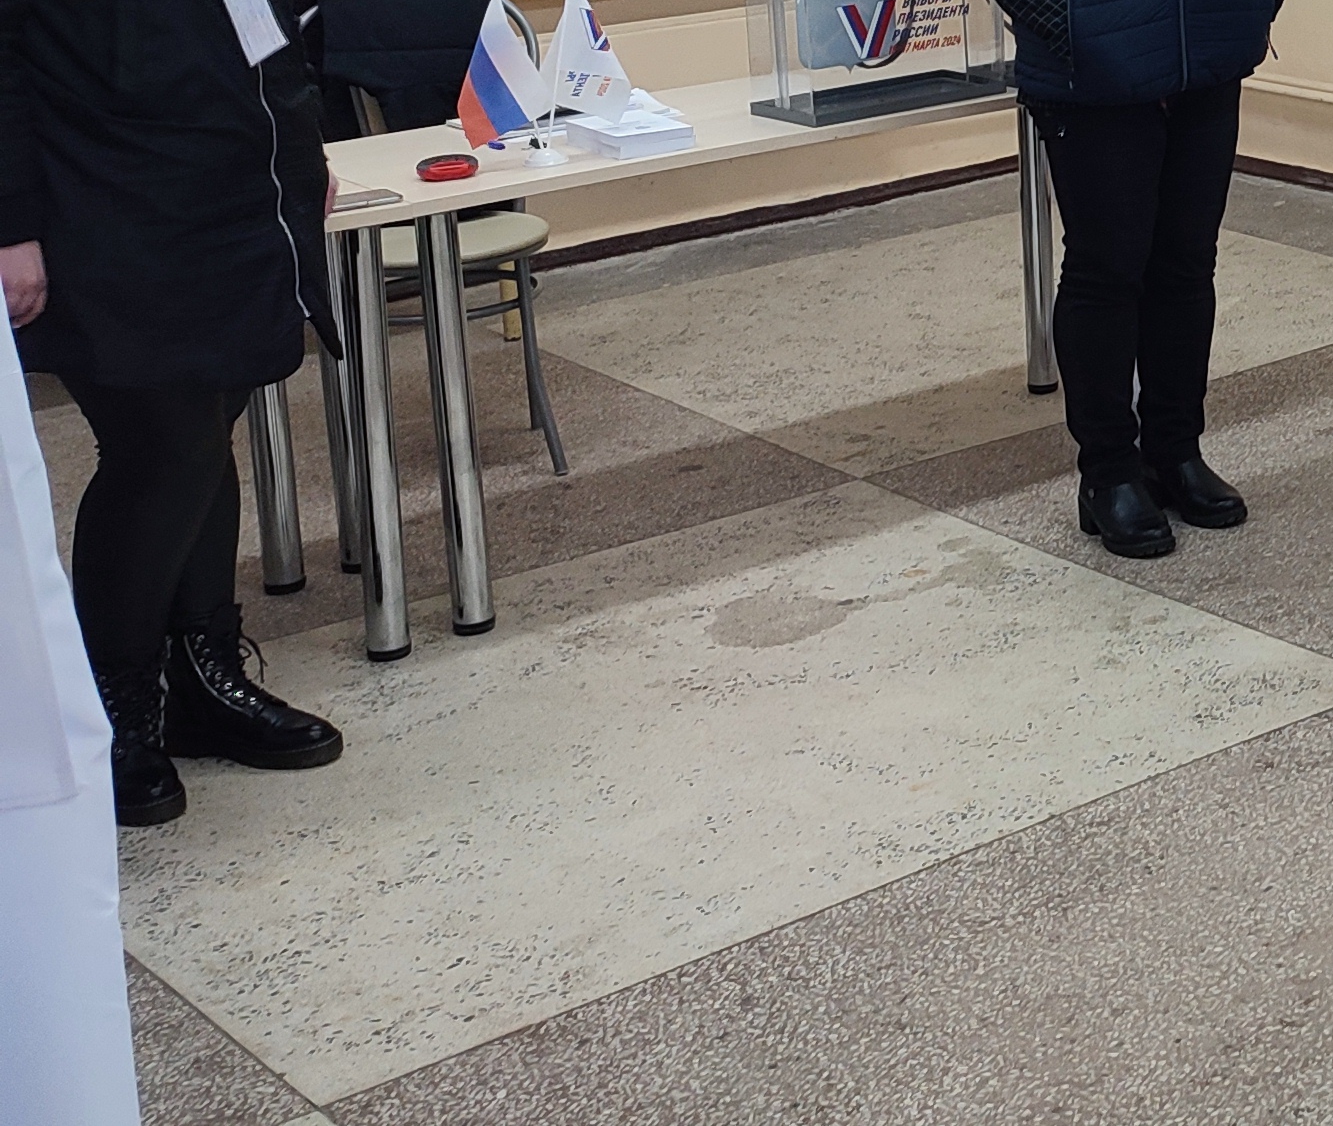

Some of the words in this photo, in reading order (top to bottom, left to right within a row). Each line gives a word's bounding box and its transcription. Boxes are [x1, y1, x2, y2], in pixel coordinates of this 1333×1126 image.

[897, 3, 970, 26] ПРЕЗИДЕНТА
[892, 23, 939, 42] РОССИИ
[912, 37, 940, 52] МАРТА
[941, 34, 962, 48] 2024
